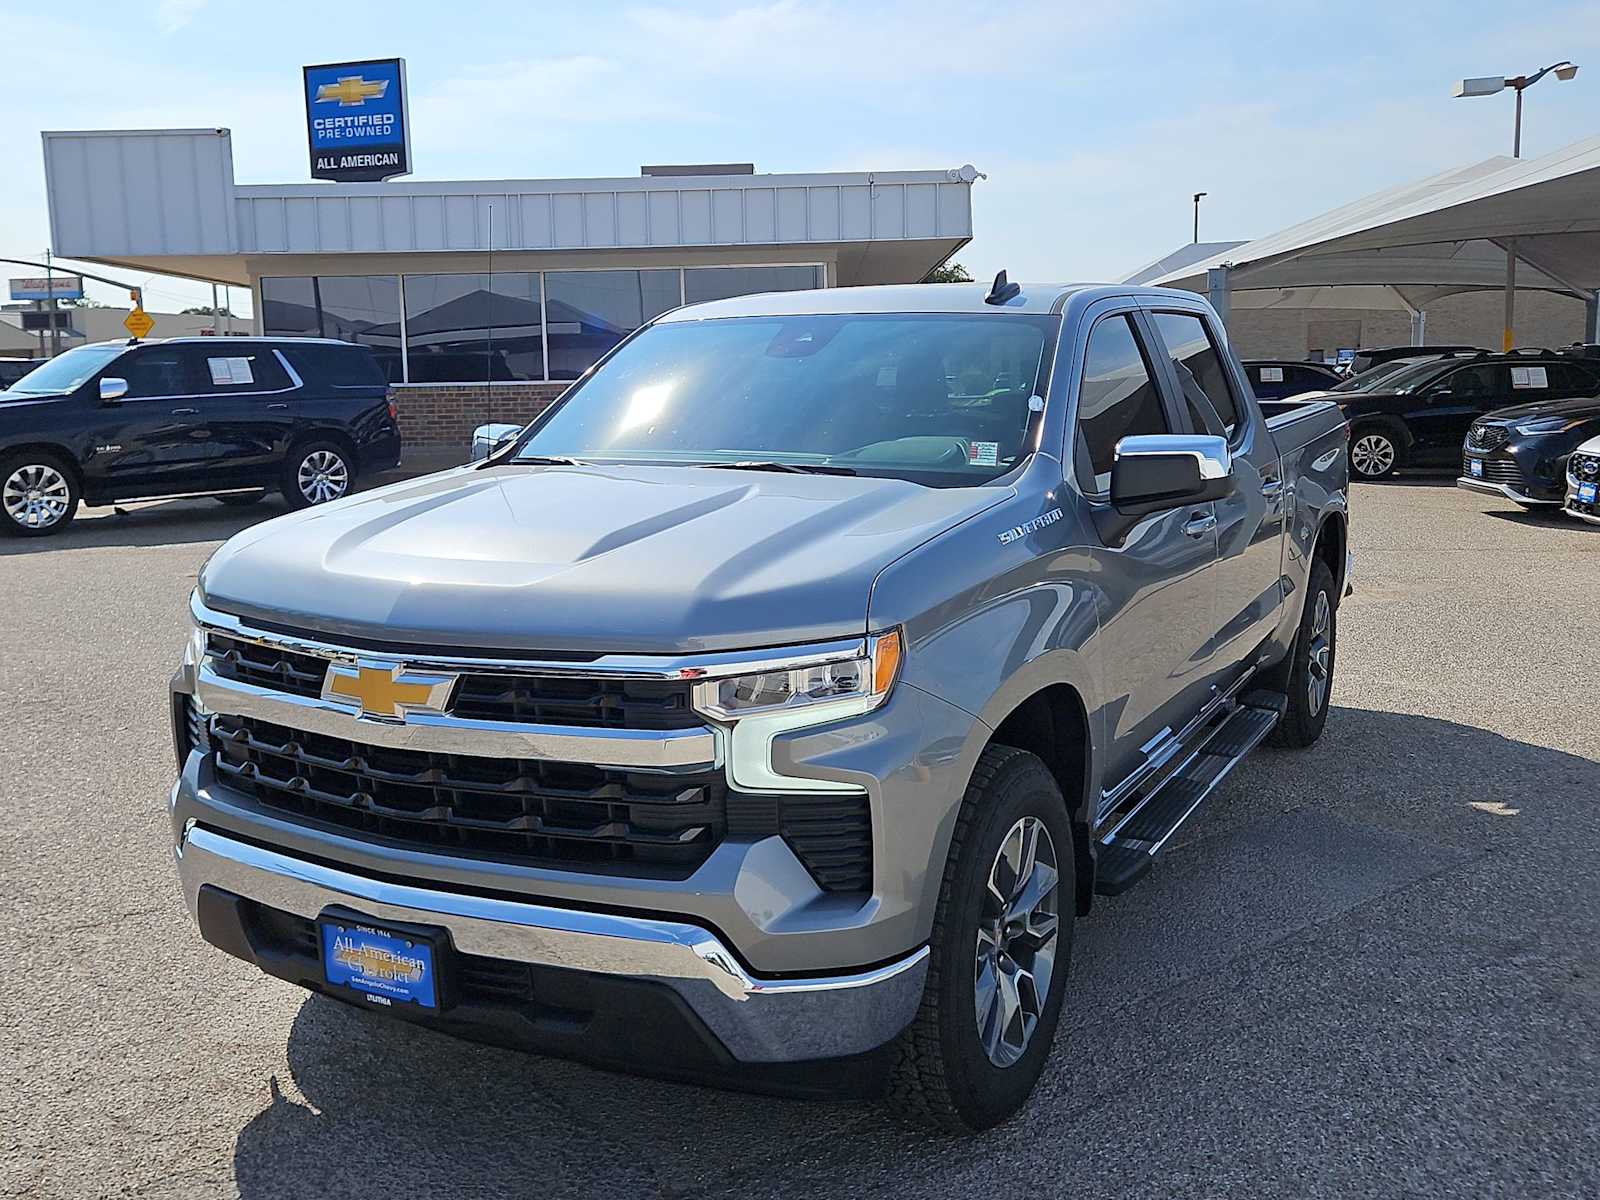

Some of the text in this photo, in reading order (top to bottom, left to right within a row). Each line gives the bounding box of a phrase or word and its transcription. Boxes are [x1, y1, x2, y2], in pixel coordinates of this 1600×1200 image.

[314, 114, 394, 129] CERTIFIED
[318, 125, 391, 139] PRE-OWNED
[317, 153, 398, 169] ALL AMERICAN
[333, 936, 425, 970] All American
